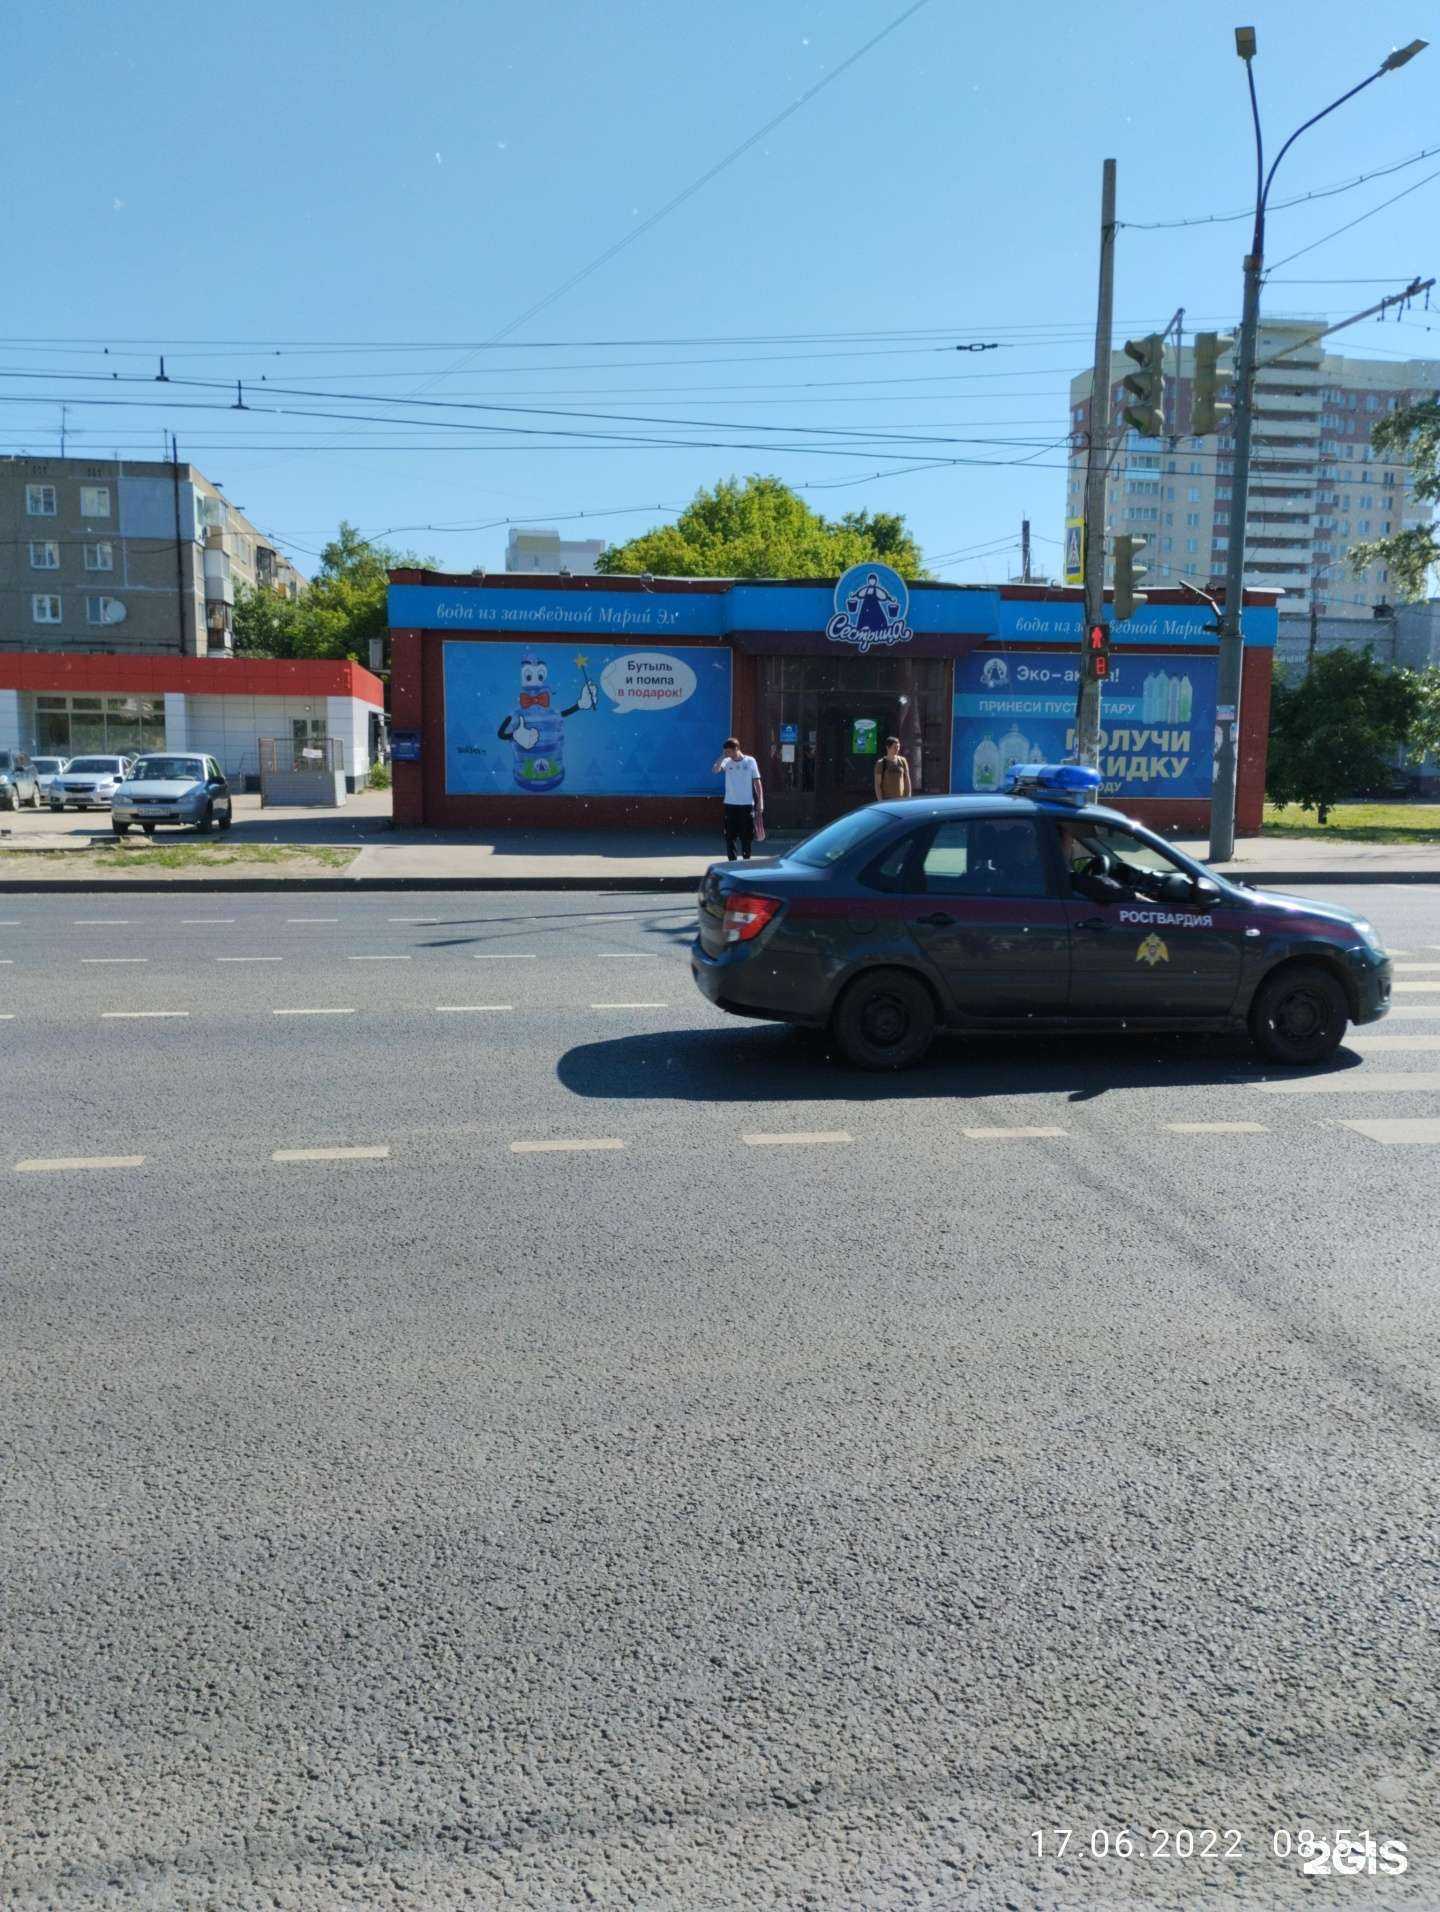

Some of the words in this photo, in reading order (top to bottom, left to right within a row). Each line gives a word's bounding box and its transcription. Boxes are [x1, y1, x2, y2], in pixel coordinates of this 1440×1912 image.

[436, 603, 473, 619] вода
[479, 608, 497, 619] из
[501, 605, 592, 622] заповедной
[599, 607, 651, 628] Марий
[827, 612, 912, 651] Сестрица
[1016, 616, 1049, 632] вода
[627, 661, 672, 673] Бутыль
[626, 676, 632, 684] и
[637, 676, 674, 685] помпа
[618, 689, 624, 697] в
[628, 687, 682, 699] подарок!
[979, 700, 1041, 713] ПРИНЕСИ
[1045, 701, 1098, 713] ПУСТ
[1104, 703, 1136, 715] ТАРУ
[1119, 910, 1213, 927] РОСГВАРДИЯ
